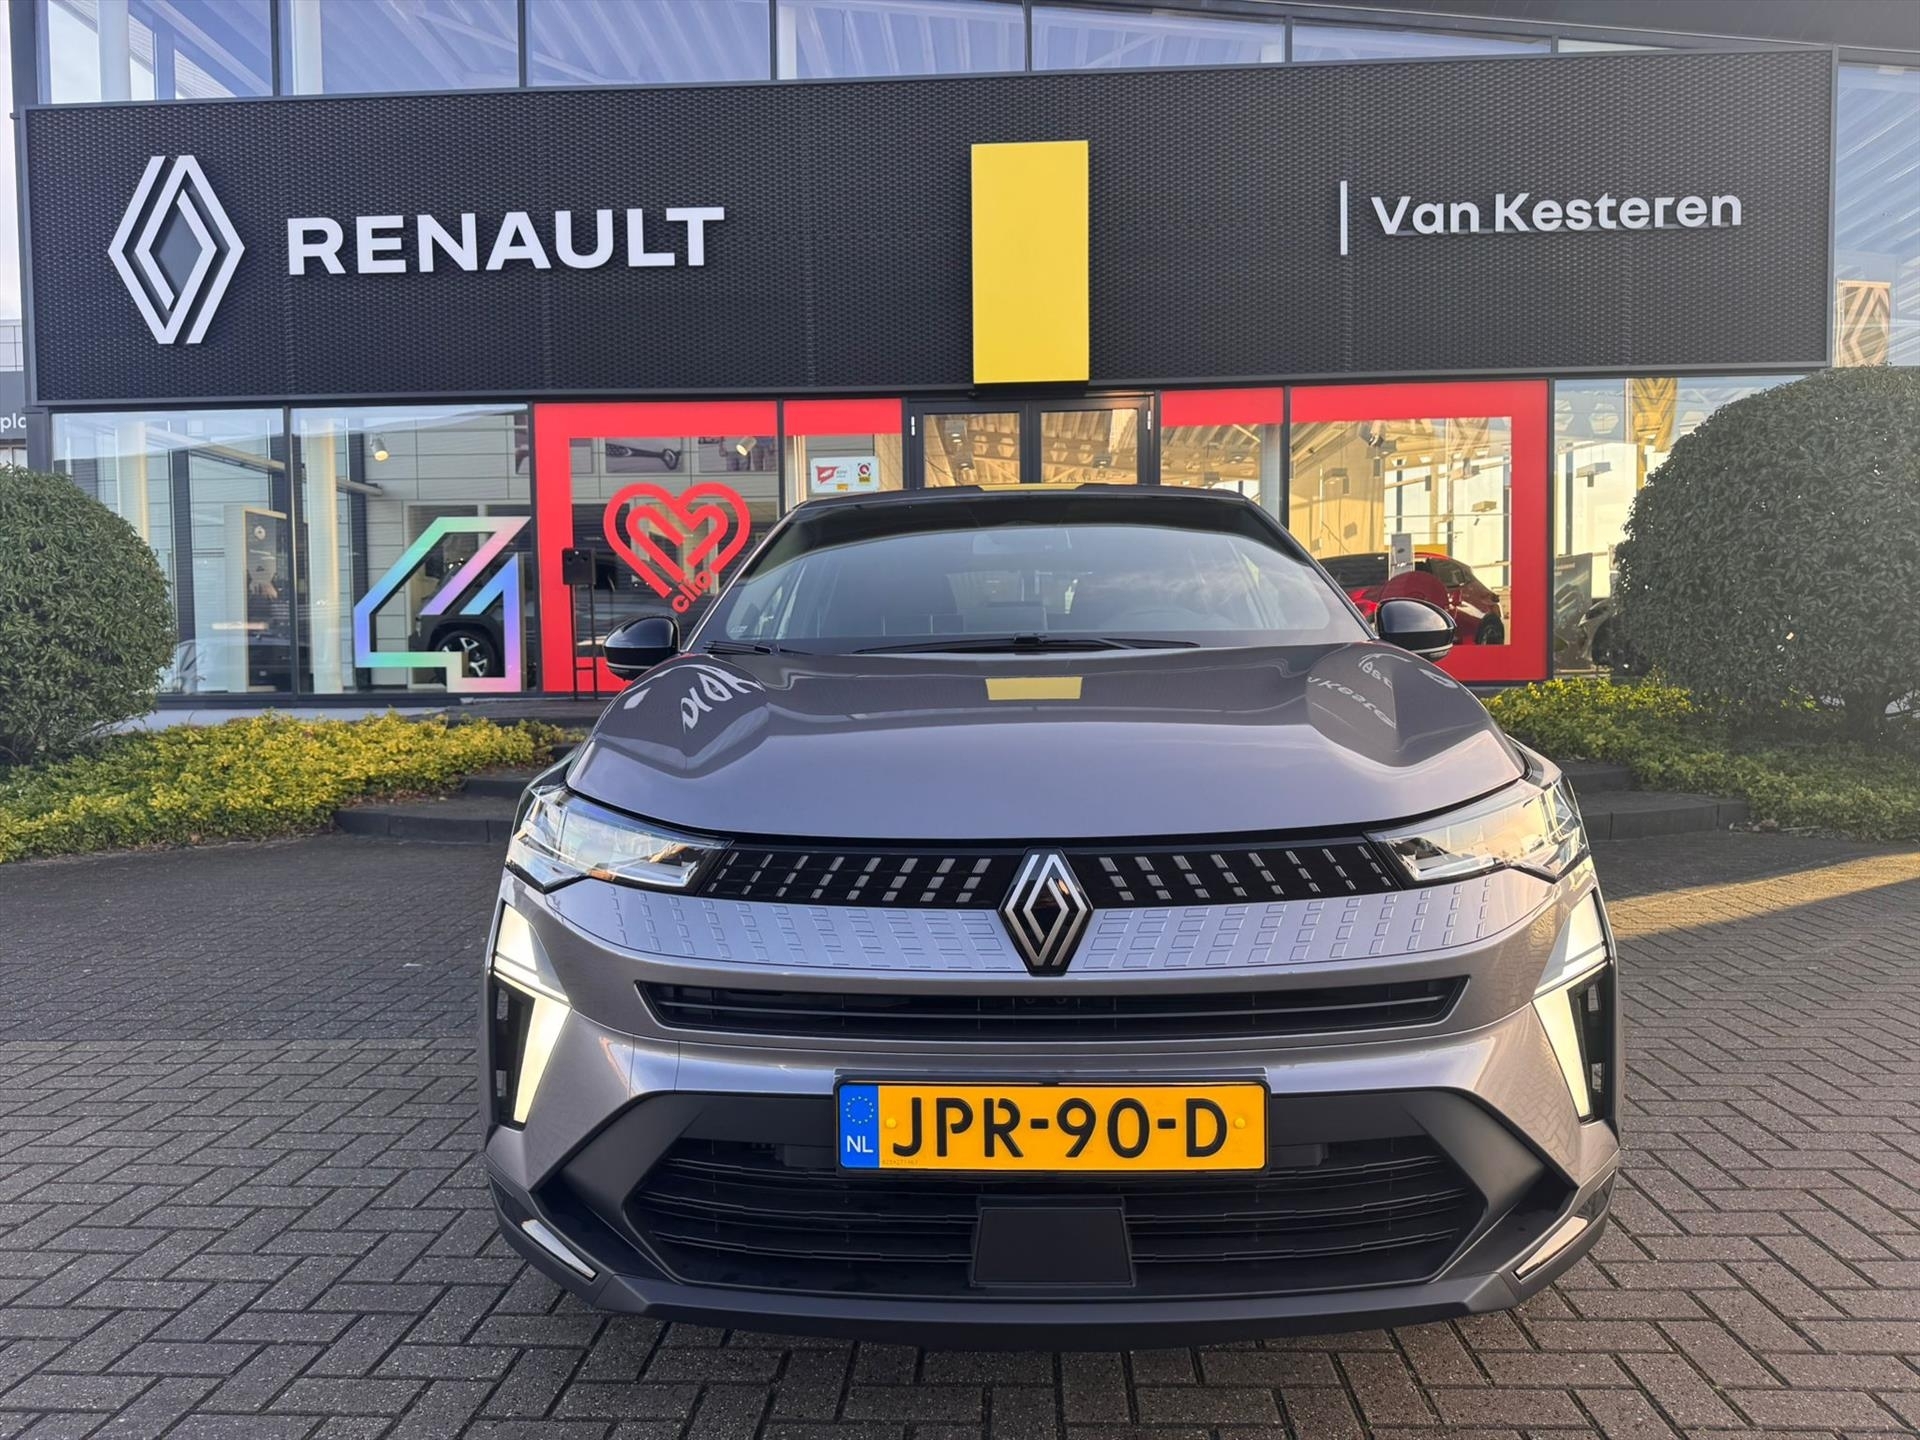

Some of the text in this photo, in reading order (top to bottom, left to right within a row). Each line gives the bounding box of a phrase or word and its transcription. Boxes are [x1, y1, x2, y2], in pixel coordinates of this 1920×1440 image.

[1371, 192, 1742, 235] Van Kesteren
[288, 206, 725, 275] RENAULT
[672, 571, 712, 613] clio
[847, 1135, 873, 1153] NL
[892, 1097, 1228, 1158] JPR-90-D
